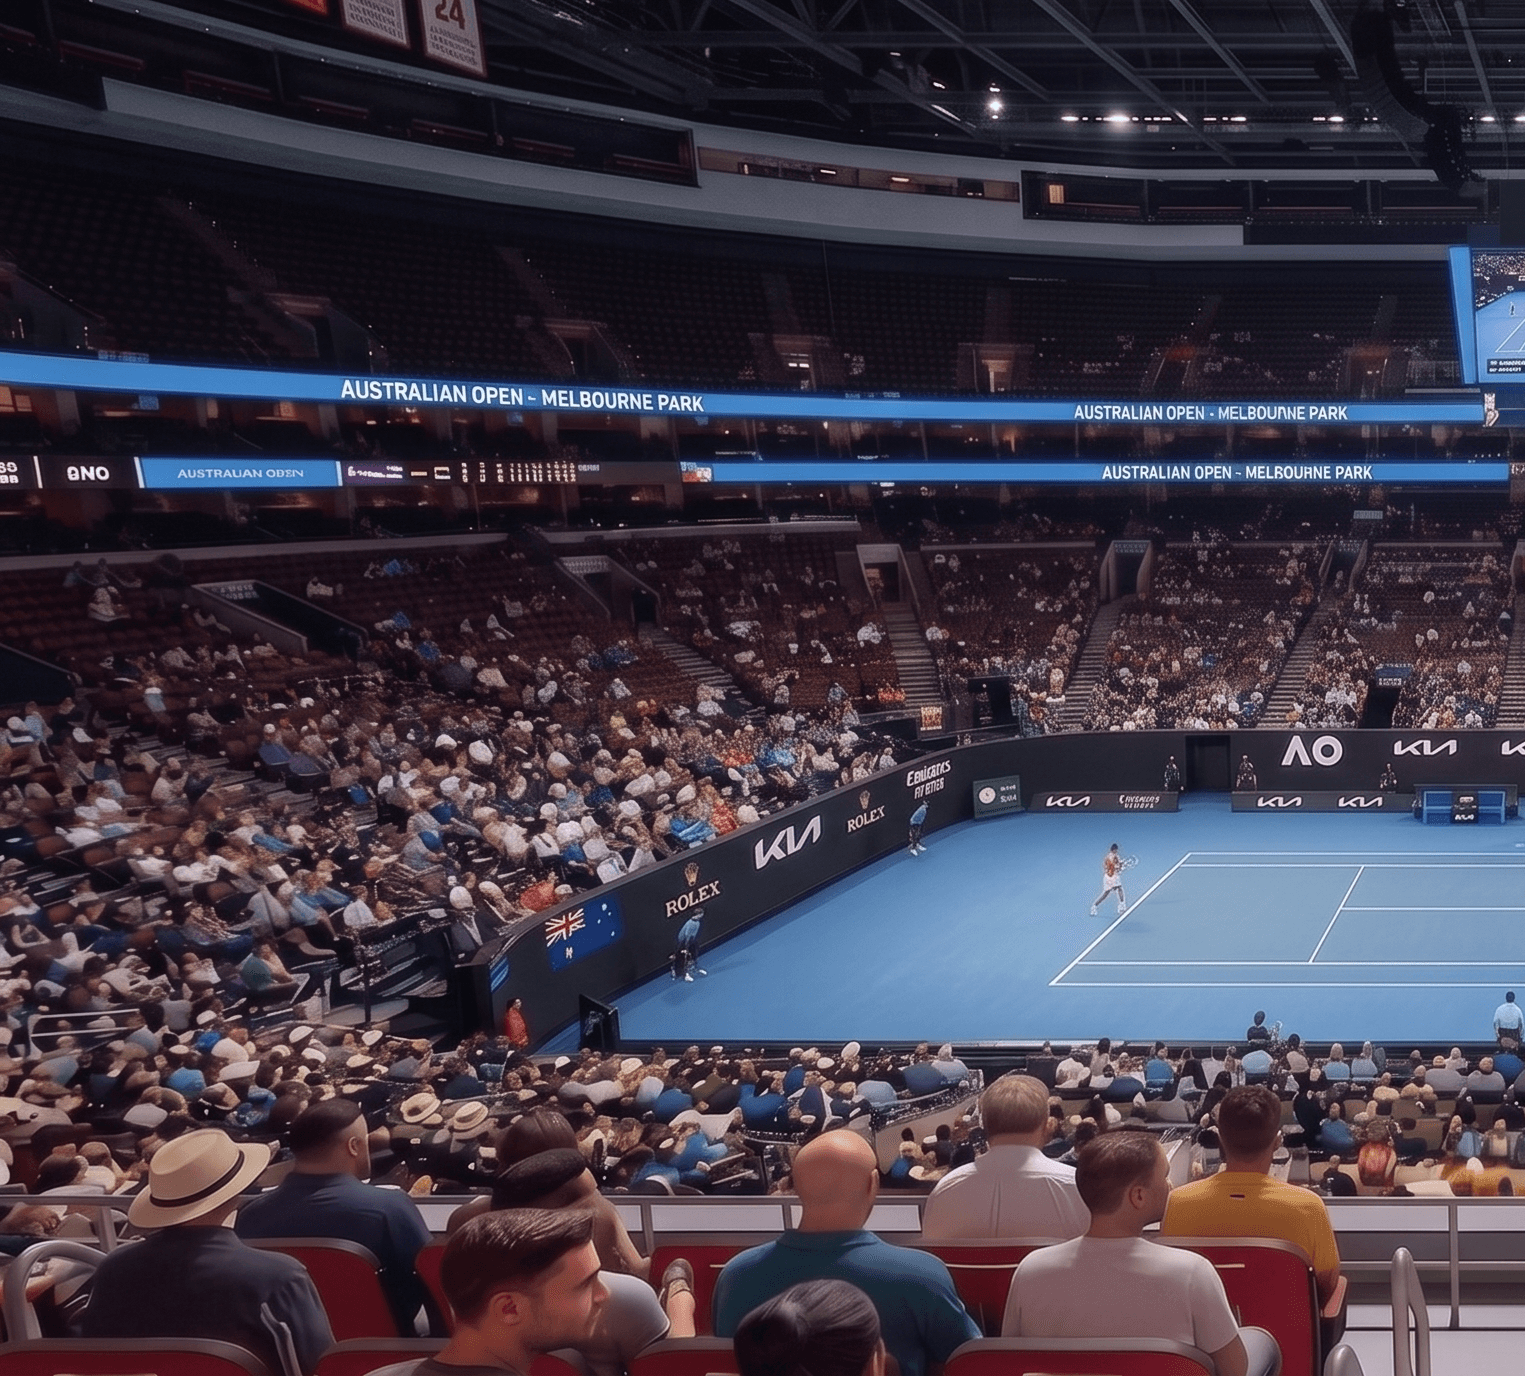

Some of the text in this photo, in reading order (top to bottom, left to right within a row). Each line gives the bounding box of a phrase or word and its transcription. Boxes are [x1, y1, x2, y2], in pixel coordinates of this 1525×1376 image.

[341, 380, 467, 403] AUSTRALIAN
[471, 386, 523, 405] OPEN
[541, 390, 653, 411] MELBOURNE
[657, 395, 704, 412] PARK
[1074, 405, 1163, 420] AUSTRALIAN
[1166, 405, 1204, 420] OPEN
[1309, 405, 1348, 420] PARK
[1102, 465, 1191, 480] AUSTRALIAN
[1194, 465, 1232, 480] OPEN
[1335, 465, 1373, 480] PARK
[1281, 735, 1343, 766] AO
[1393, 739, 1457, 756] KIA
[1045, 796, 1091, 807] KIA
[1257, 796, 1383, 807] KIA KIA
[847, 805, 886, 833] ROLEX
[754, 814, 823, 870] KIA
[665, 880, 721, 918] ROLEX
